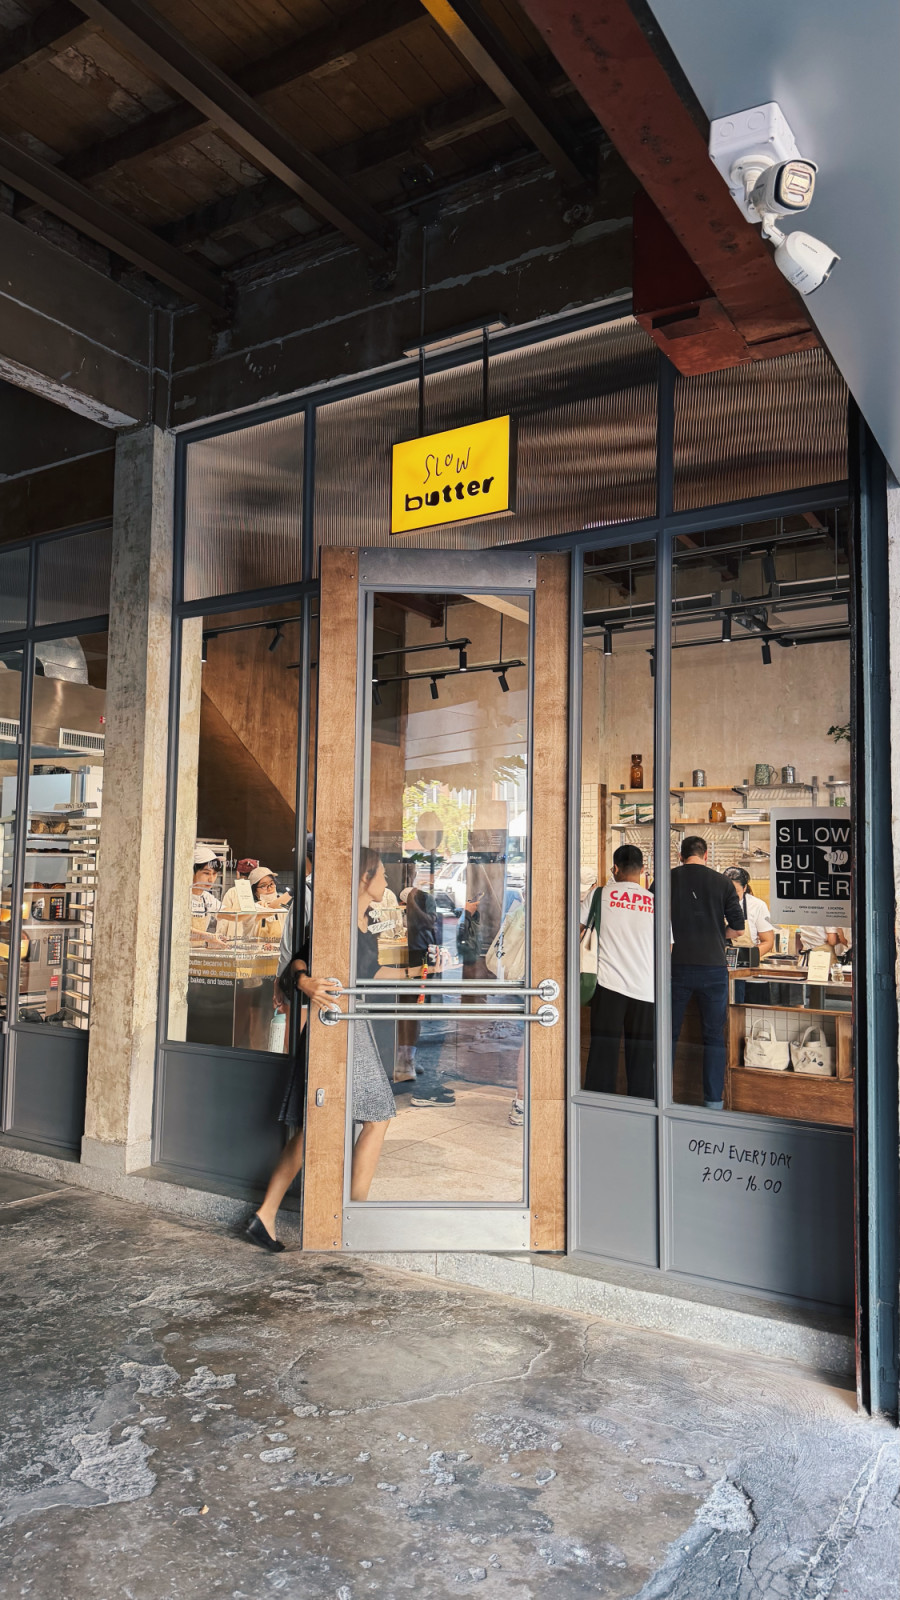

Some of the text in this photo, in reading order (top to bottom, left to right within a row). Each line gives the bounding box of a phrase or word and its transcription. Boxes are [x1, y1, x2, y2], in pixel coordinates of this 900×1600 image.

[405, 476, 495, 512] butter
[779, 827, 850, 843] SLOW
[781, 854, 809, 869] BU
[779, 879, 850, 897] TTER
[609, 890, 654, 906] CAPR
[610, 901, 636, 911] DOLCE
[689, 1139, 725, 1156] OPEN
